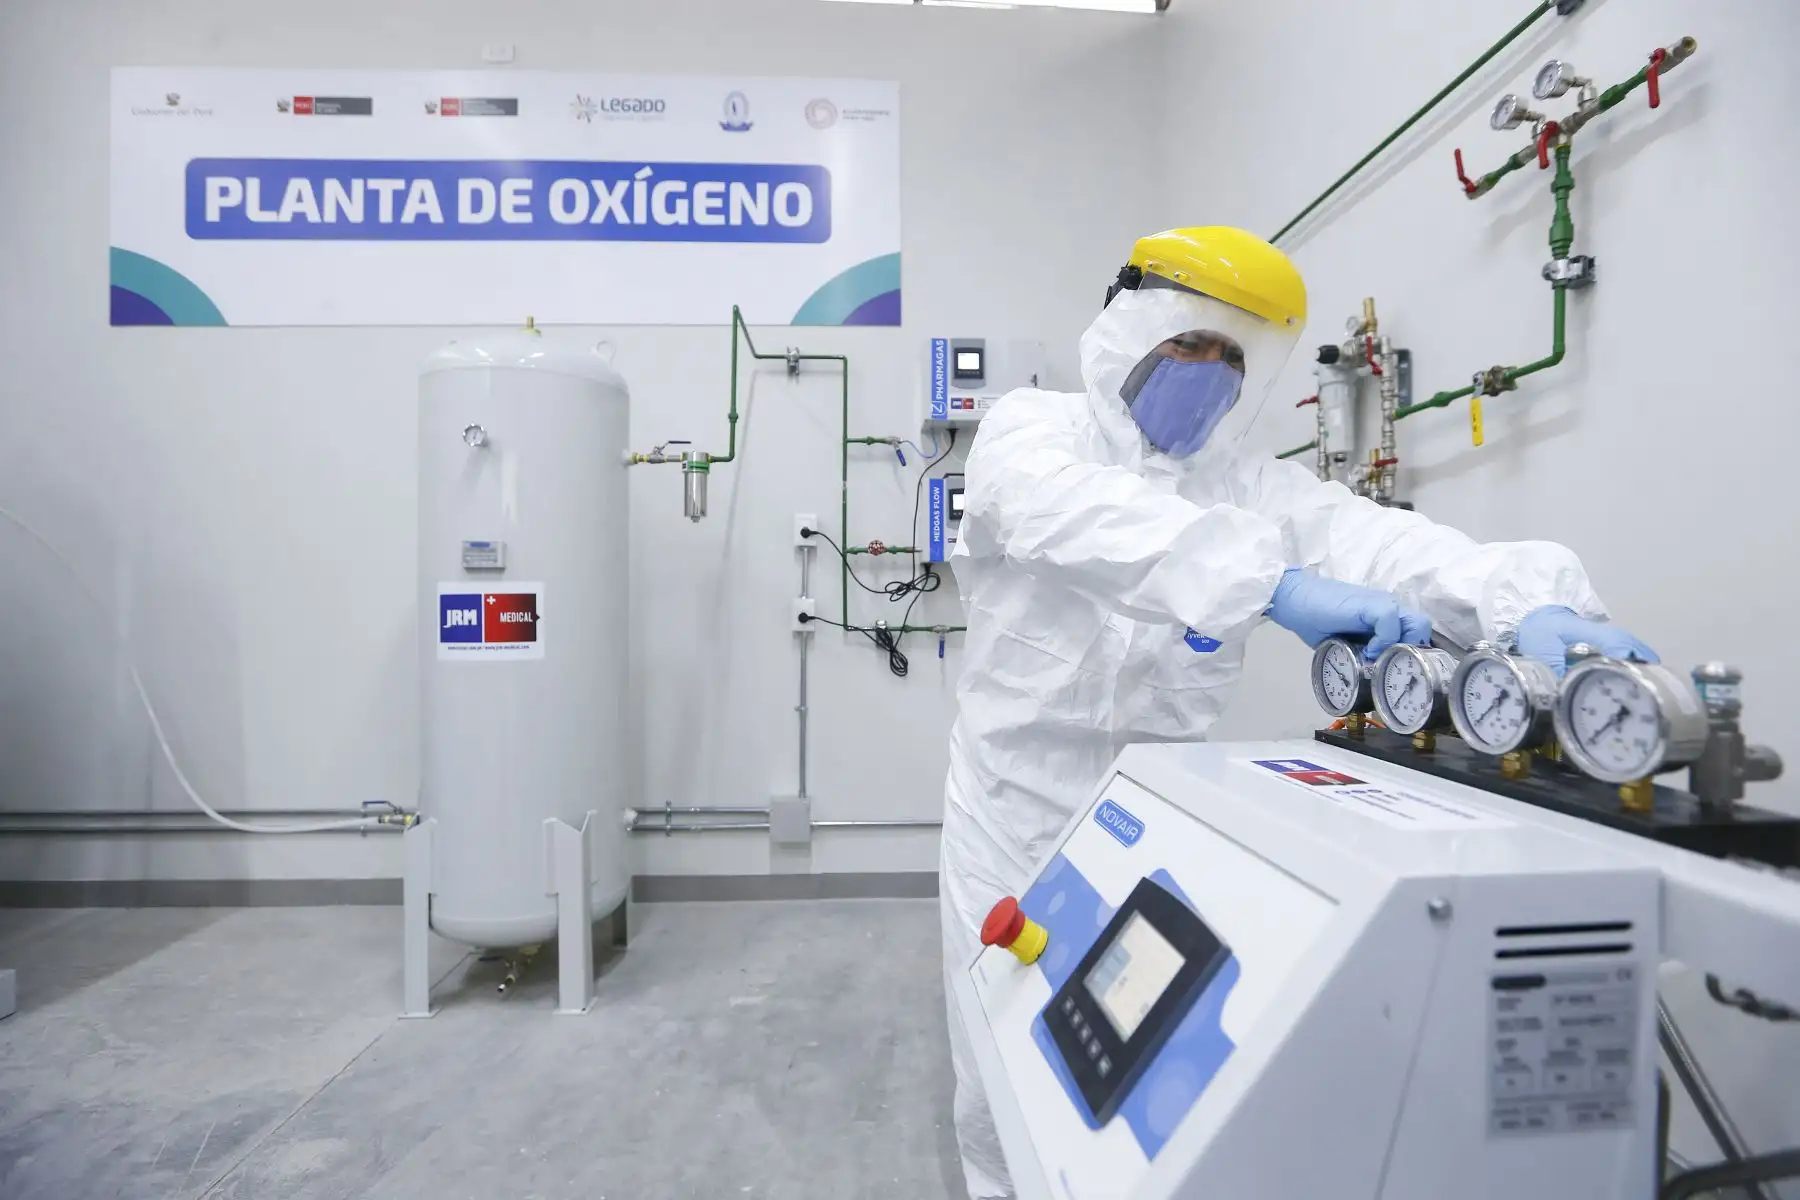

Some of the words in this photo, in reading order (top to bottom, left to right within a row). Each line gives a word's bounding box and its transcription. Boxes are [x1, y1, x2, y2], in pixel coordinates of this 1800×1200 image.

[205, 175, 444, 224] PLANTA
[458, 177, 533, 224] DE
[548, 165, 814, 227] OXÍGENO
[935, 339, 945, 400] PHARMAGAS
[443, 609, 478, 628] JRM
[499, 612, 533, 623] MEDICAL
[1099, 804, 1139, 841] NOVAIR
